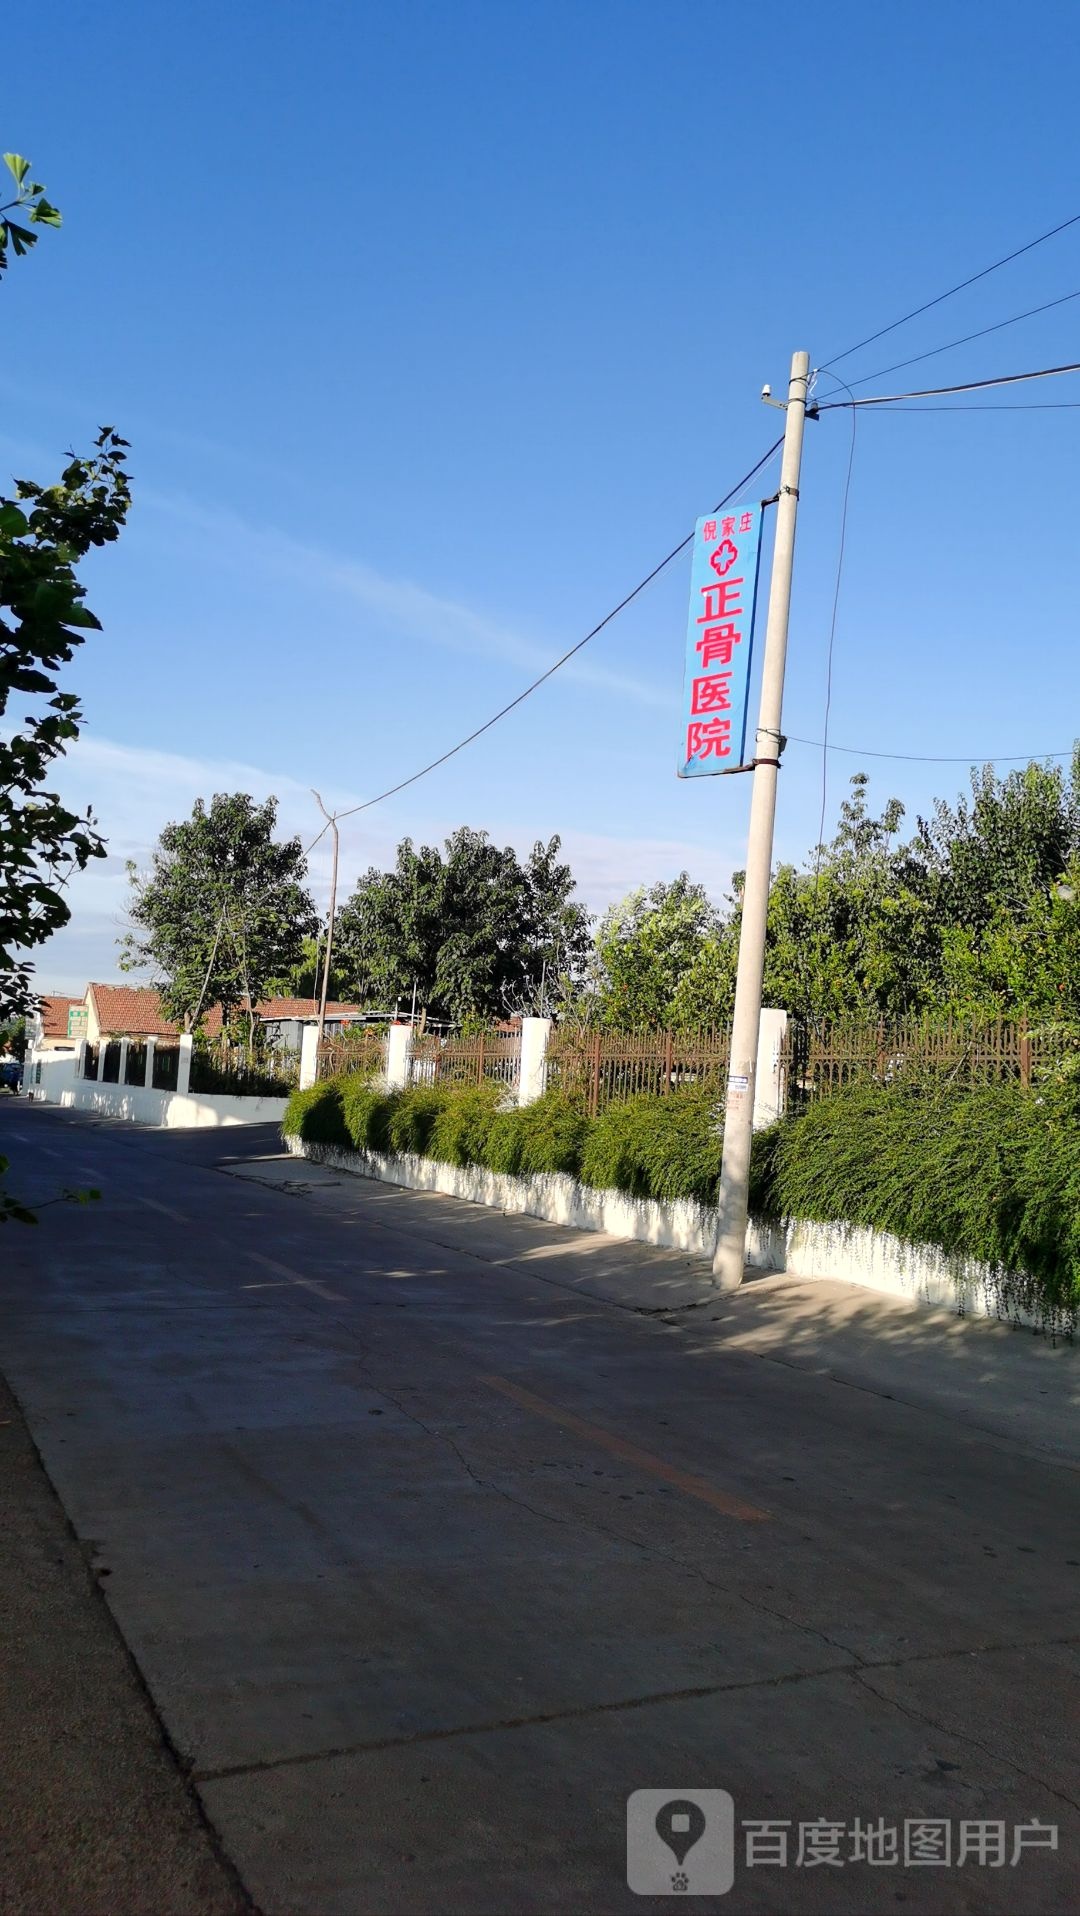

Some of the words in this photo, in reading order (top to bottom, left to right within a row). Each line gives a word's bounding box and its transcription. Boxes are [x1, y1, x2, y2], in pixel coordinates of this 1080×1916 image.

[703, 512, 753, 541] 倪家庄
[687, 577, 744, 761] 正骨医院
